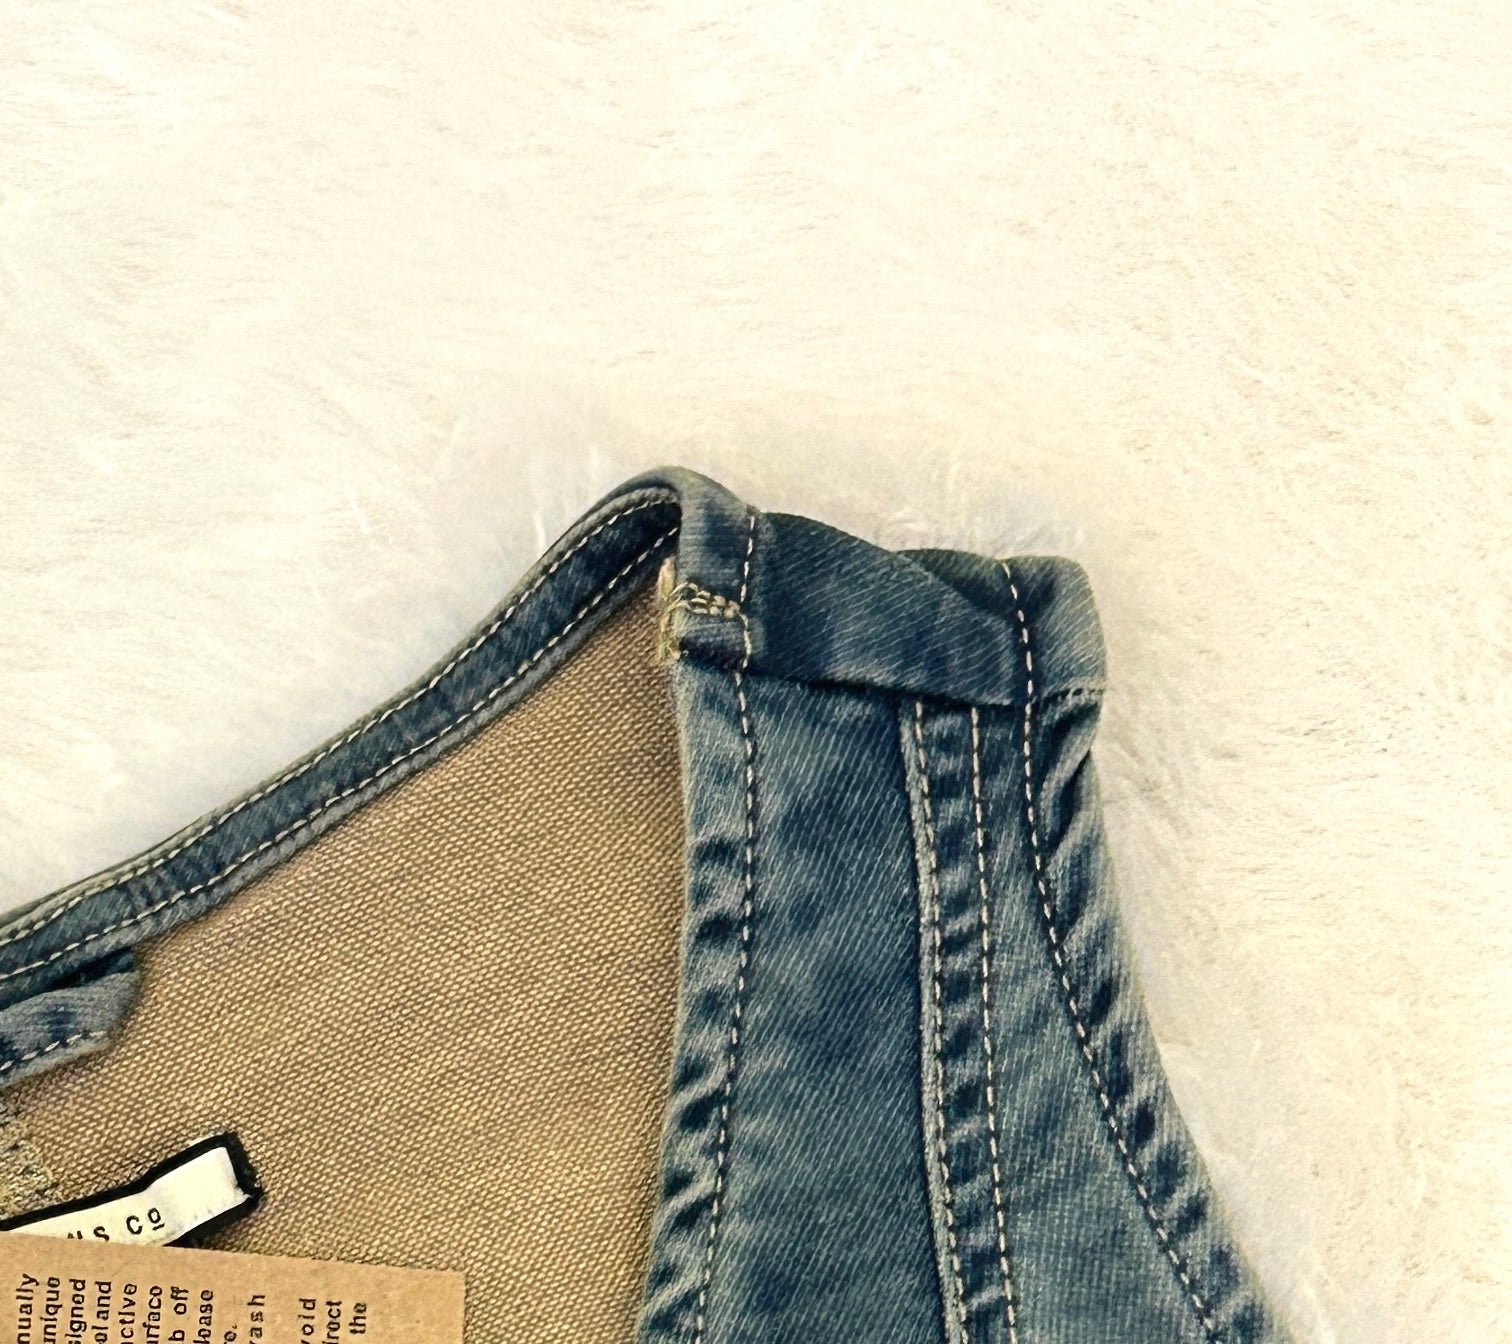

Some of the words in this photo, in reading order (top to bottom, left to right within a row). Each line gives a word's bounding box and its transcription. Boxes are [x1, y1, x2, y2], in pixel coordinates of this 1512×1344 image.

[94, 1281, 111, 1321] and
[171, 1286, 188, 1314] off
[349, 1303, 367, 1335] the
